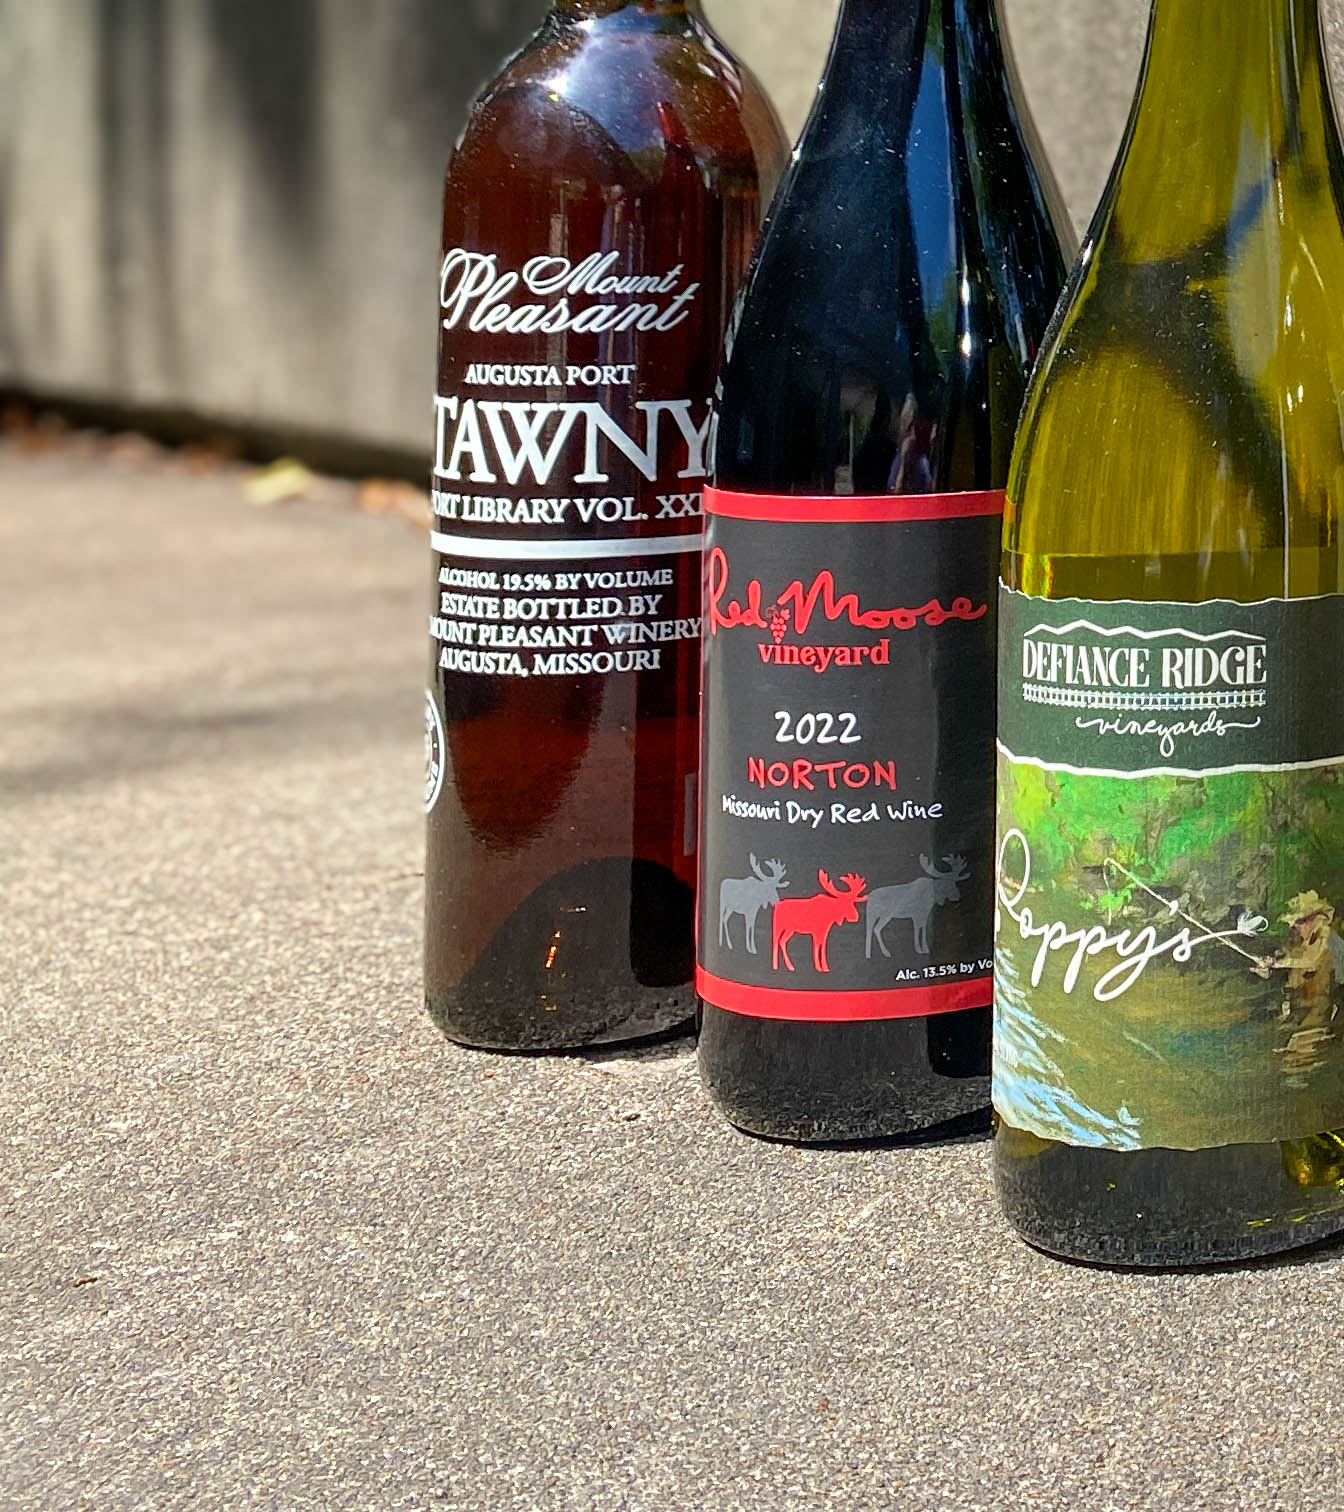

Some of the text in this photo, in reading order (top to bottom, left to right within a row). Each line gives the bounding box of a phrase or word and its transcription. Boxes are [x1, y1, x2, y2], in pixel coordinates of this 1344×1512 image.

[522, 250, 685, 296] Mount
[440, 248, 700, 334] Pleasant
[464, 363, 636, 386] AUGUSTA PORT
[433, 394, 717, 486] TAWNY
[461, 496, 572, 522] LIBRARY
[573, 497, 649, 522] VOL.
[655, 493, 704, 519] XXI
[438, 567, 674, 591] ALCOHOL 19.5% BY VOLUME
[710, 547, 988, 636] Red Moose
[441, 592, 664, 620] ESTATE BOTTLED BY
[477, 623, 600, 648] PLEASANT
[602, 617, 702, 643] WINERY
[438, 645, 661, 677] AUGUSTA, MISSOURI
[757, 638, 891, 674] vineyard
[1022, 640, 1268, 690] DEFIANCE RIDGE
[774, 710, 862, 745] 2022
[1075, 711, 1261, 757] vineyards
[748, 757, 897, 791] NORTON
[722, 794, 944, 829] Missouri Dry Red Wine
[998, 828, 1240, 1002] Poppy's
[896, 958, 993, 981] Alc. 13.5% by Vo
